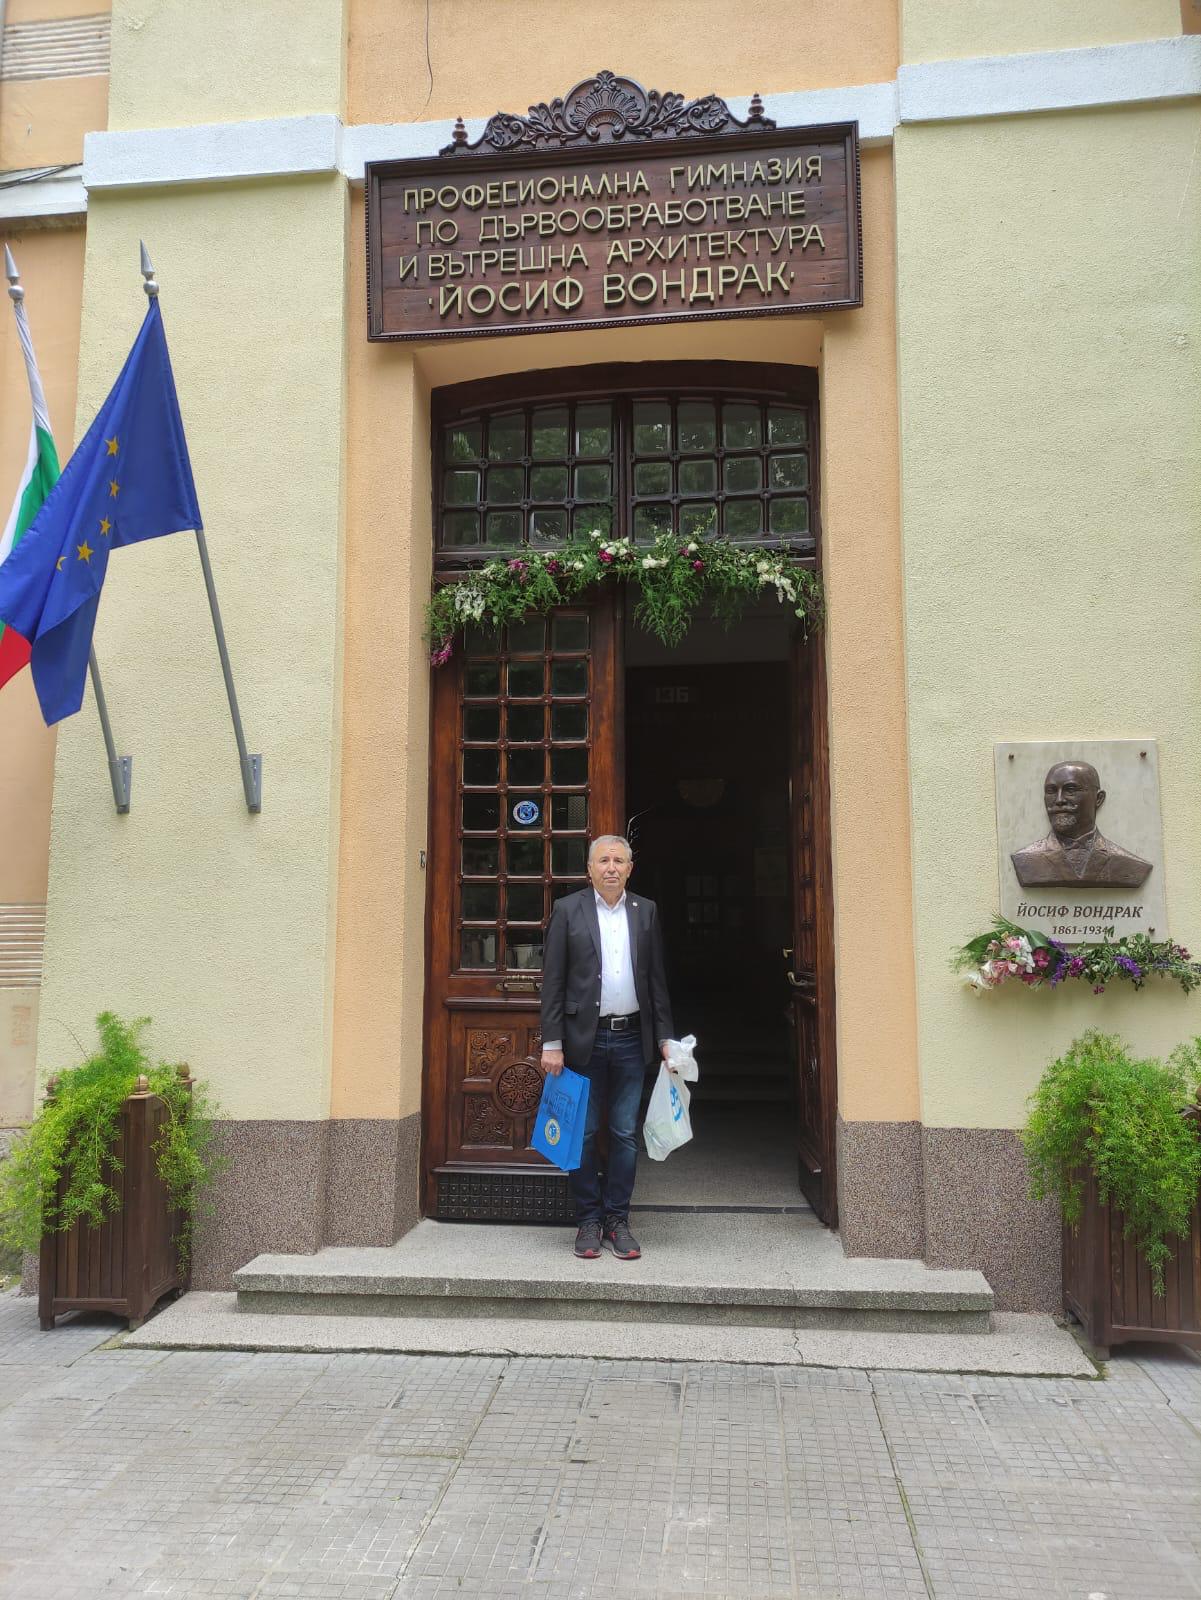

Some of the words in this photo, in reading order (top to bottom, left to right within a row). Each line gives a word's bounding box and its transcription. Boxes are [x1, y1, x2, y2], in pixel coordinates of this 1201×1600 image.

[404, 170, 649, 213] ПРОФЕСИОНАЛНА
[670, 155, 822, 192] ГИМНАЗИЯ
[416, 219, 458, 245] ПО
[478, 191, 805, 244] ДЪРВООБРАБОТВАНЕ
[399, 255, 418, 280] И
[428, 243, 588, 278] ВЪТРЕШНА
[607, 224, 825, 265] АРХИТЕКТУРА
[1016, 902, 1070, 918] ЙОСИФ
[1073, 905, 1144, 920] ВОНДРАК
